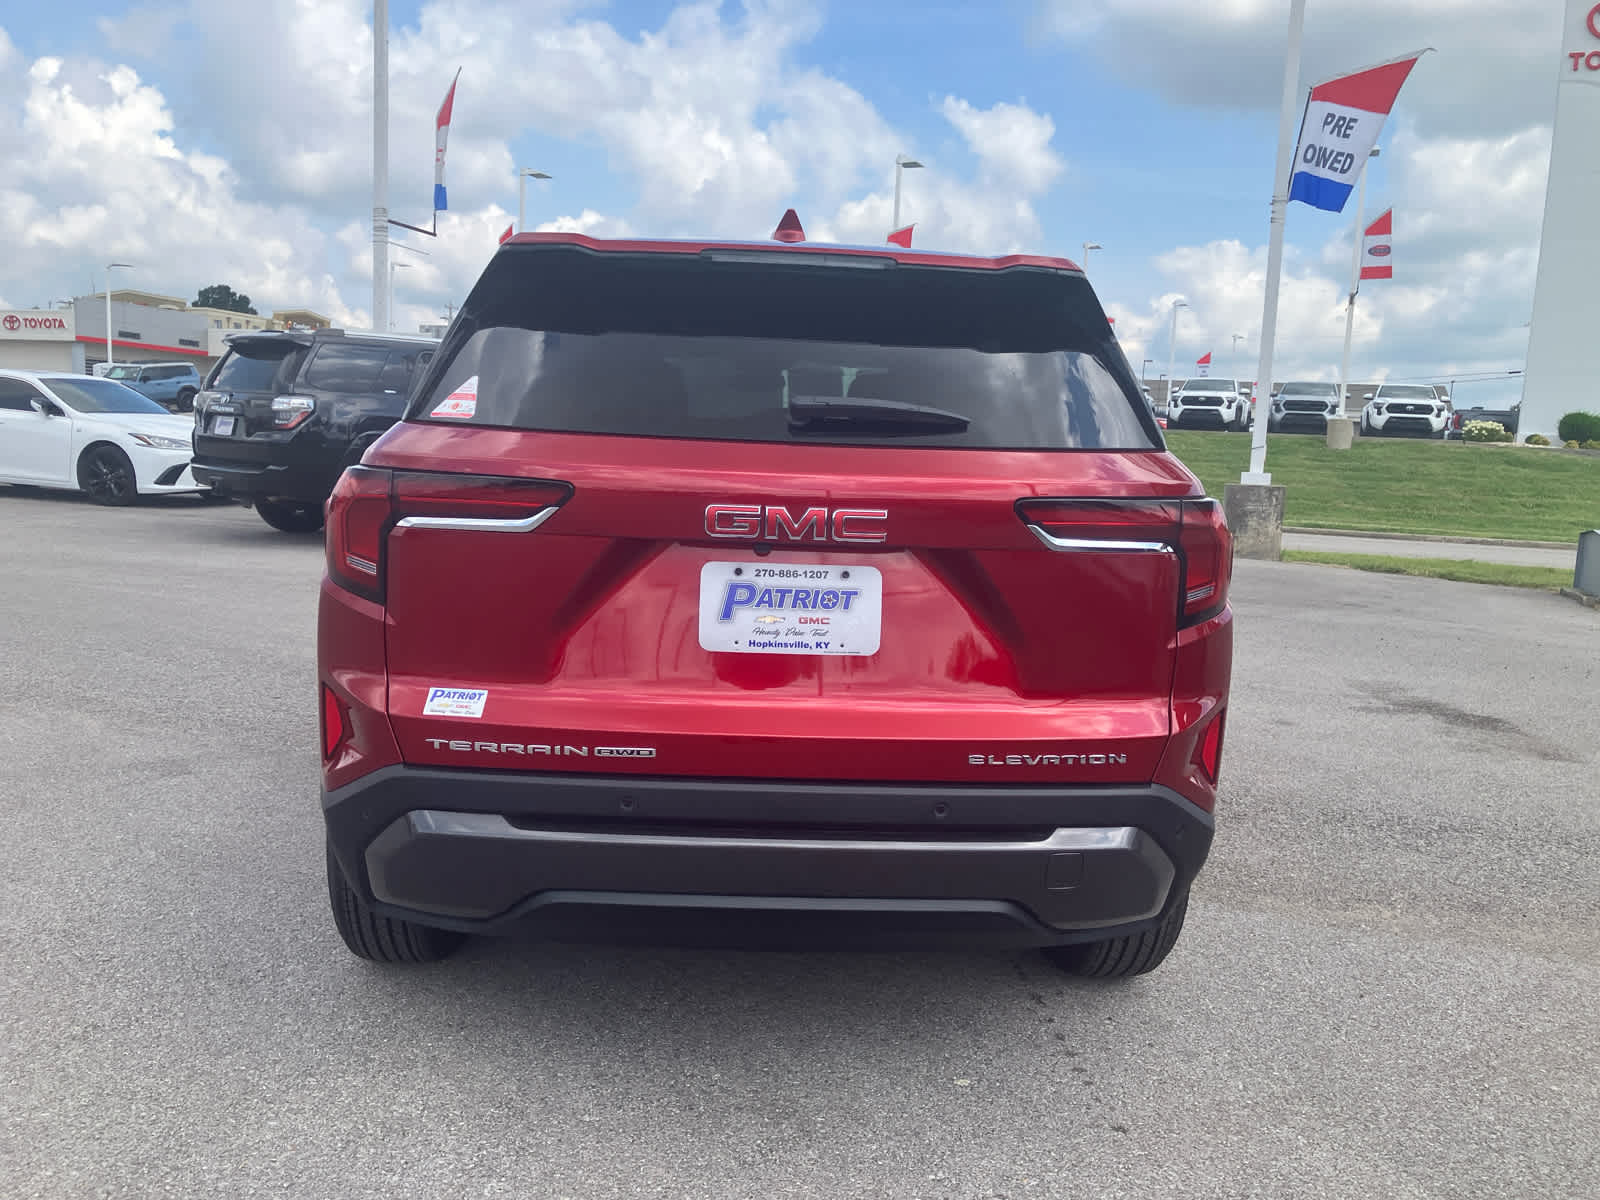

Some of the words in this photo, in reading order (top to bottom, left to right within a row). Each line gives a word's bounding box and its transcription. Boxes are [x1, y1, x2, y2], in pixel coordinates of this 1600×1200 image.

[1322, 112, 1359, 139] PRE
[23, 317, 66, 329] TOYOTA
[704, 504, 888, 543] GMC
[754, 568, 830, 580] 270-886-1207
[798, 616, 831, 625] GMC
[748, 639, 813, 650] Hopkinsville,
[815, 641, 831, 650] KY
[424, 738, 589, 757] TERRAIN
[594, 747, 657, 758] AWD
[968, 753, 1128, 766] ELEVATION
